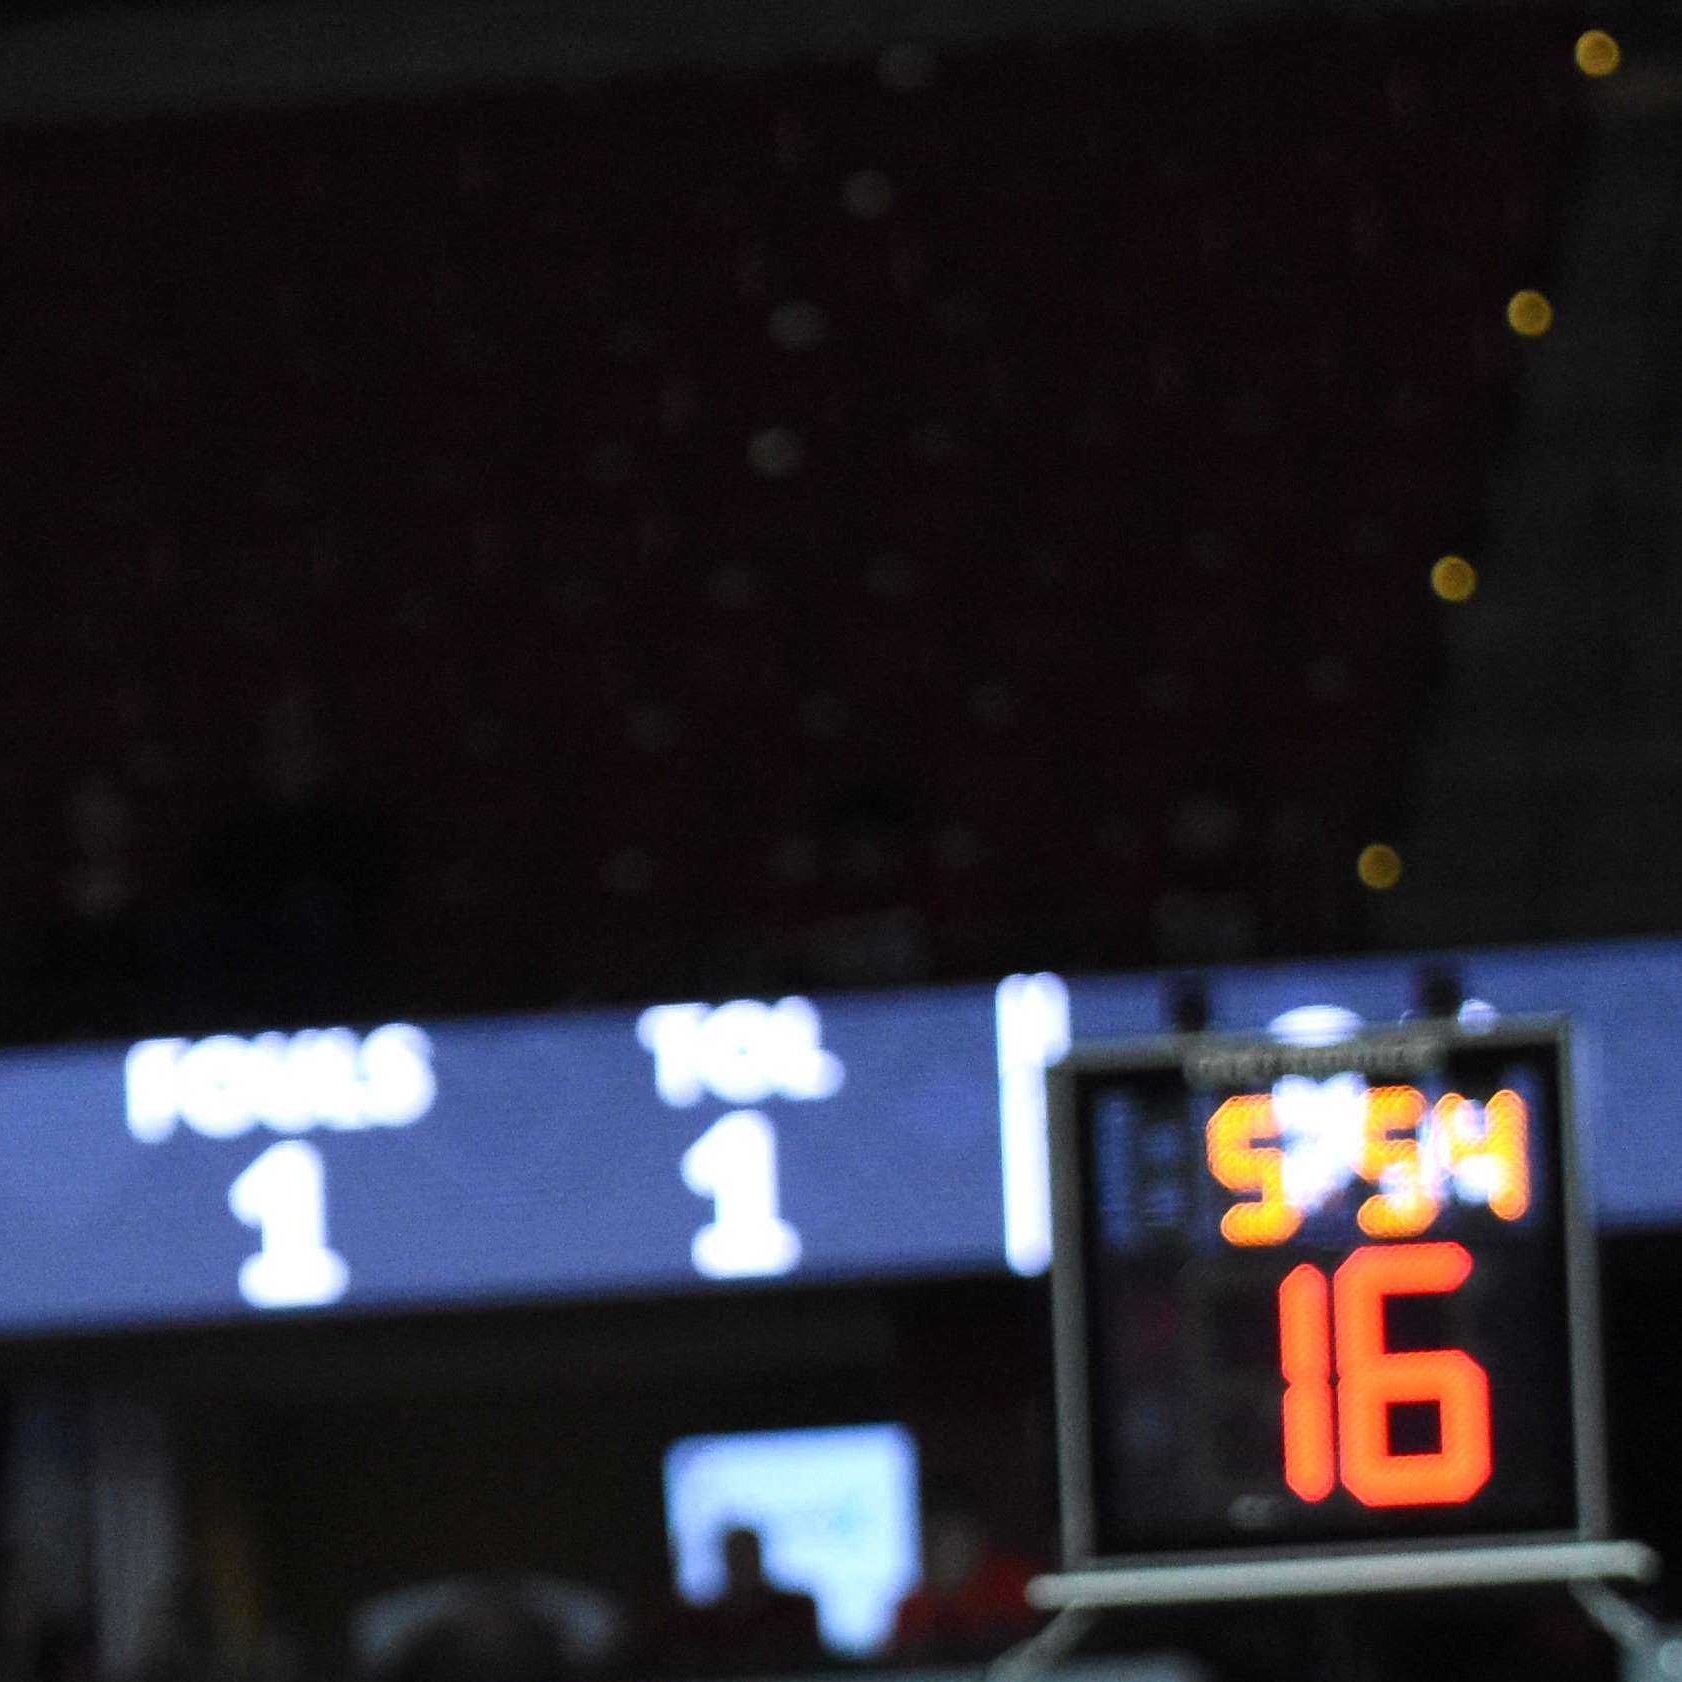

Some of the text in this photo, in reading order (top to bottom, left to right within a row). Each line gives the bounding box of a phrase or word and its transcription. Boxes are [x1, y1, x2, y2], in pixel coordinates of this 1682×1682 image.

[228, 1138, 350, 1309] 1
[681, 1109, 803, 1280] 1
[1204, 1085, 1531, 1248] 554
[1279, 1241, 1493, 1507] 16
